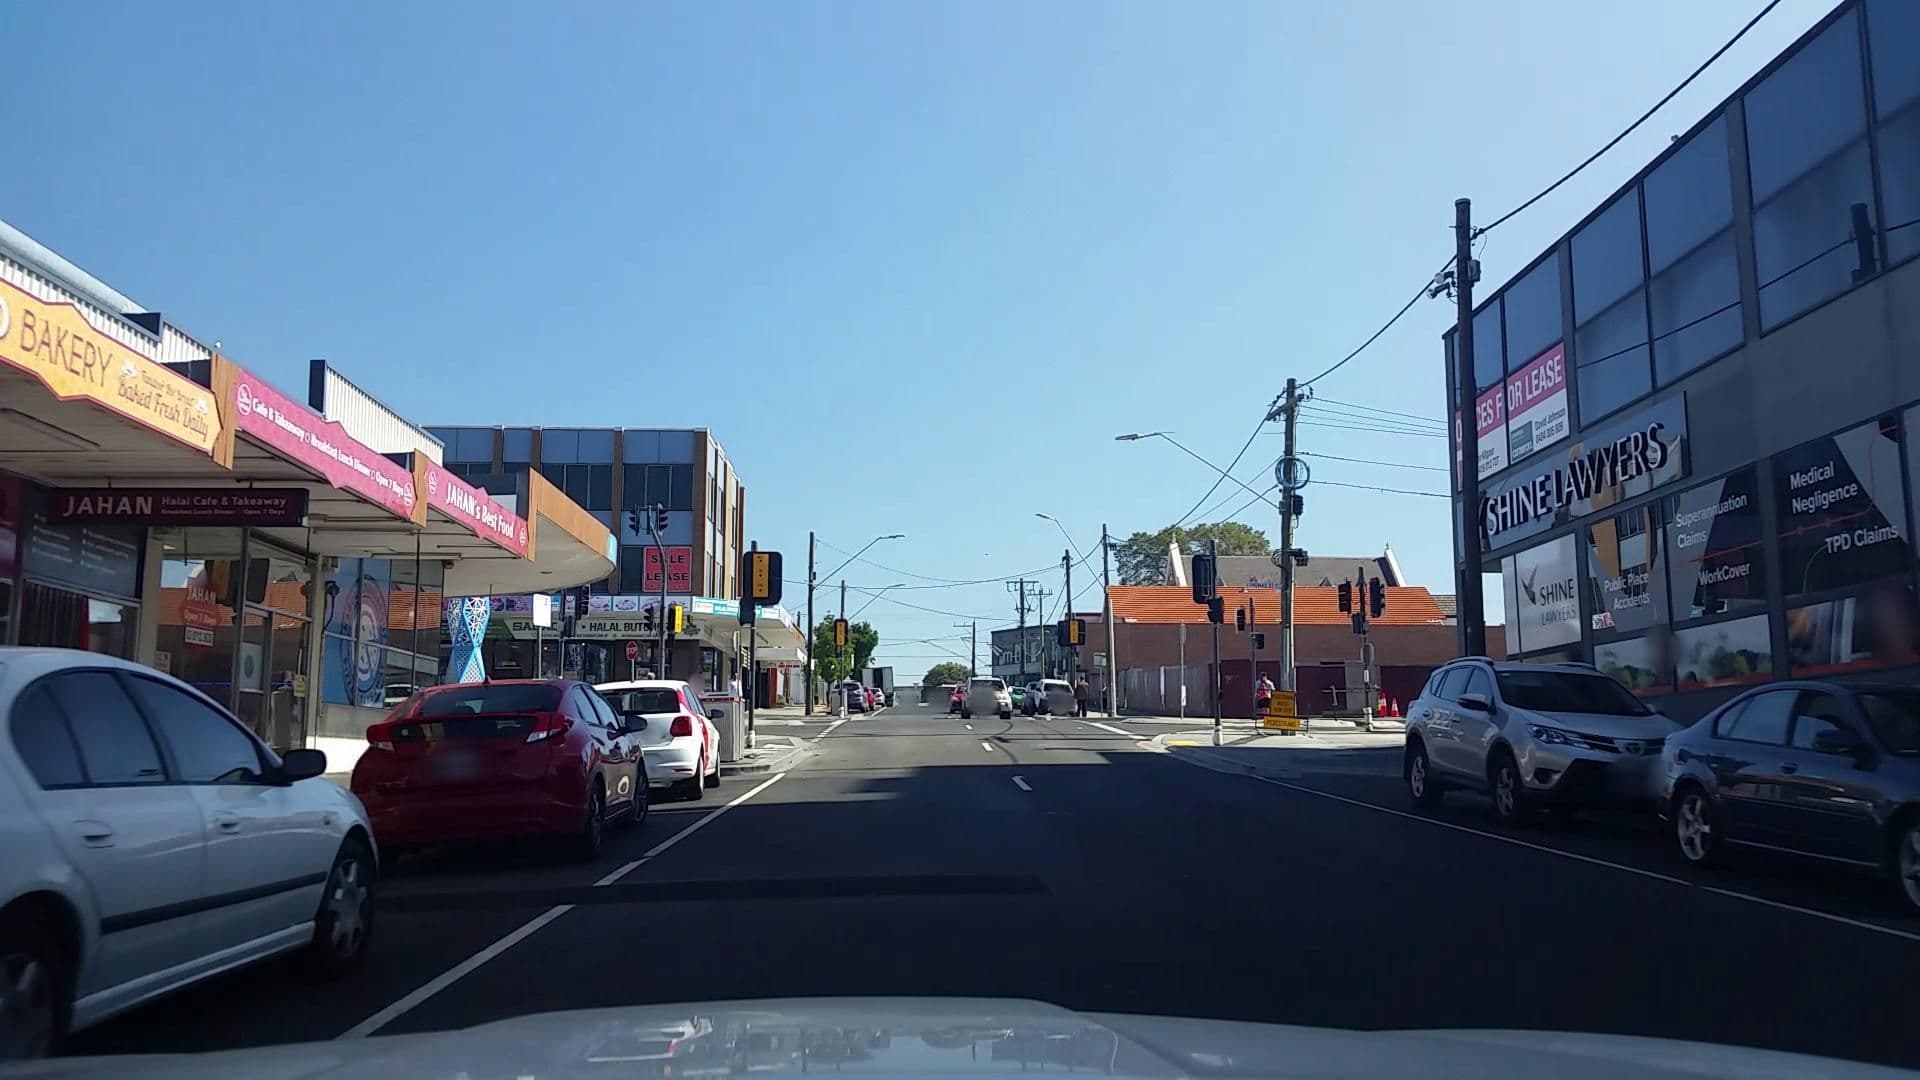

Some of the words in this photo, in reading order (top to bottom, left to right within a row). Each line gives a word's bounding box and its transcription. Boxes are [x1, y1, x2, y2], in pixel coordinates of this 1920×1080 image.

[21, 308, 113, 388] BAKERY
[1525, 354, 1562, 401] LEASE
[1486, 474, 1550, 536] SHINE
[1552, 423, 1665, 509] LAWYERS
[1789, 461, 1835, 490] Medical
[64, 495, 153, 517] JAHAN
[161, 496, 190, 506] Halal
[193, 496, 217, 506] Cafe
[221, 497, 229, 506] &
[232, 497, 287, 508] Takeaway
[1791, 482, 1858, 514] Negligence
[1675, 493, 1748, 528] Superannuation
[1677, 530, 1708, 549] Claims
[1824, 535, 1851, 554] TPD
[1853, 524, 1898, 547] Claims
[651, 555, 685, 564] SLE
[1603, 575, 1627, 593] Public
[1627, 570, 1650, 588] Place
[1698, 562, 1751, 586] WorkCover
[187, 585, 217, 605] JAHAN
[1540, 578, 1575, 606] SHINE
[1613, 592, 1651, 611] Accidents
[1541, 604, 1577, 626] LAWYERS
[589, 622, 621, 632] HALAL
